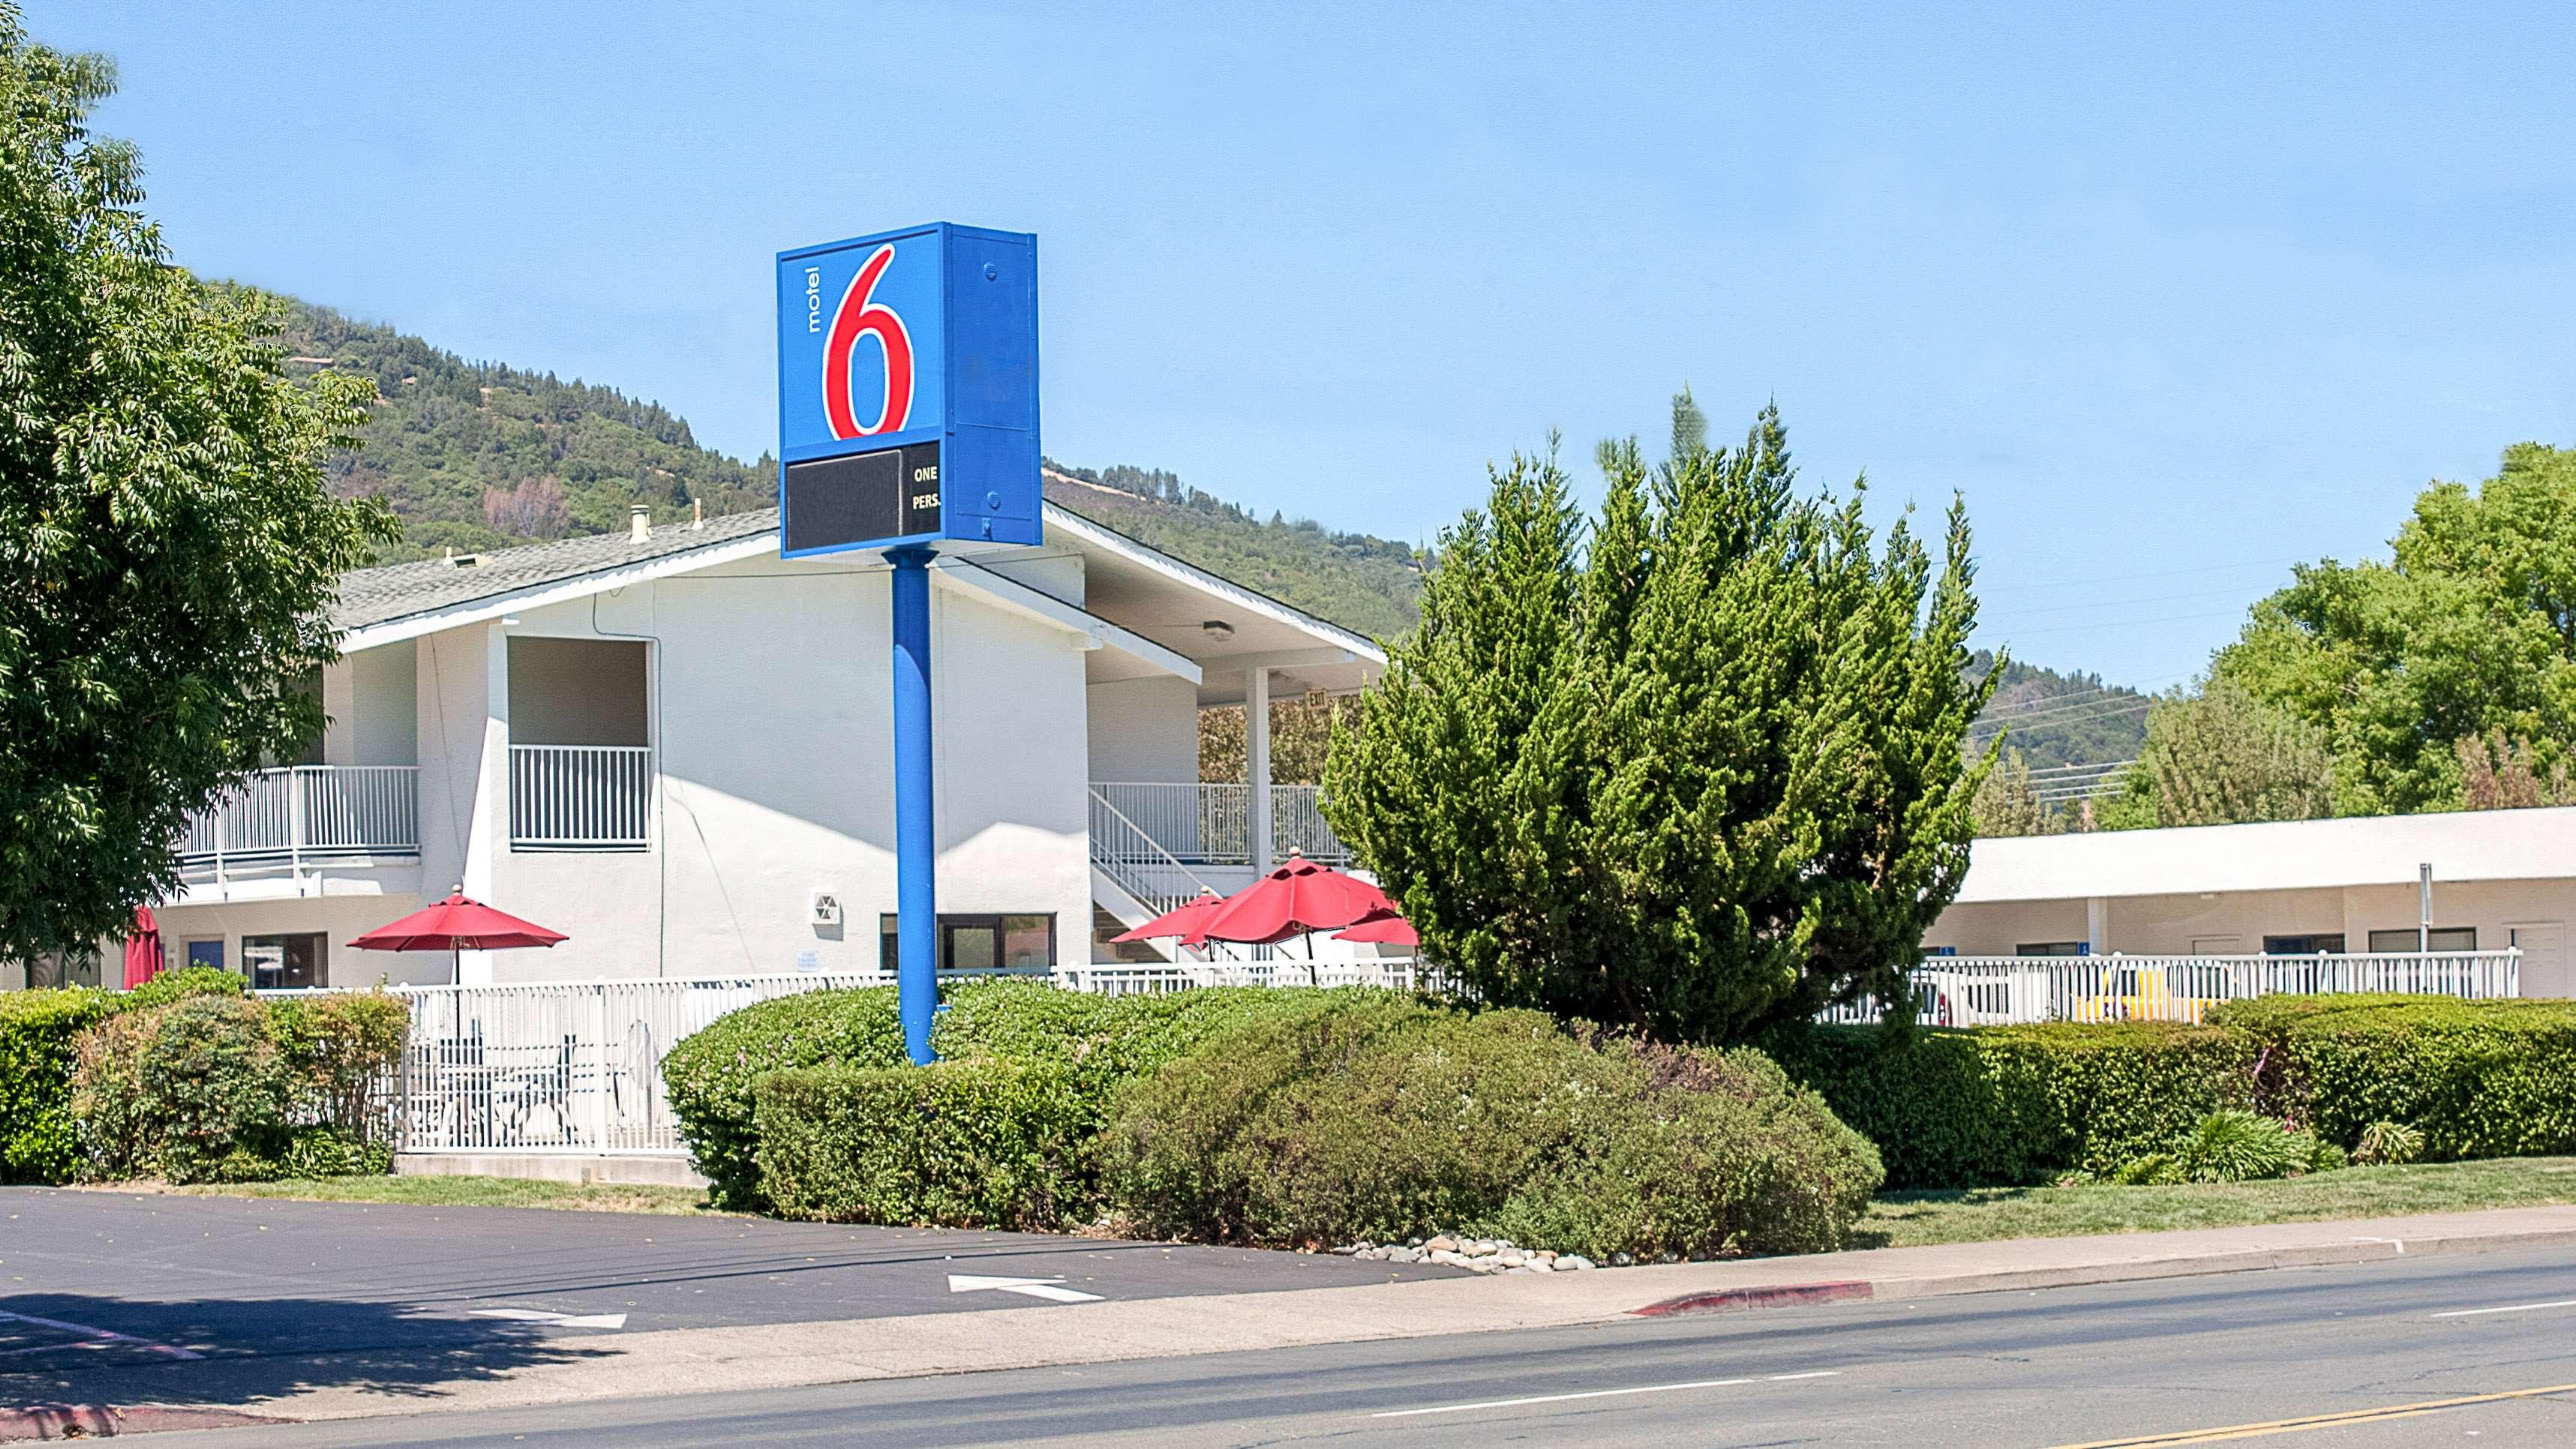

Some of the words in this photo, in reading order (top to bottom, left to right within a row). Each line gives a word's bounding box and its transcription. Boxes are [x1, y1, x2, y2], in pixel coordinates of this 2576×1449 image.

[804, 266, 820, 332] motel
[822, 243, 914, 441] 6
[914, 466, 938, 482] ONE
[912, 493, 941, 510] PERS.
